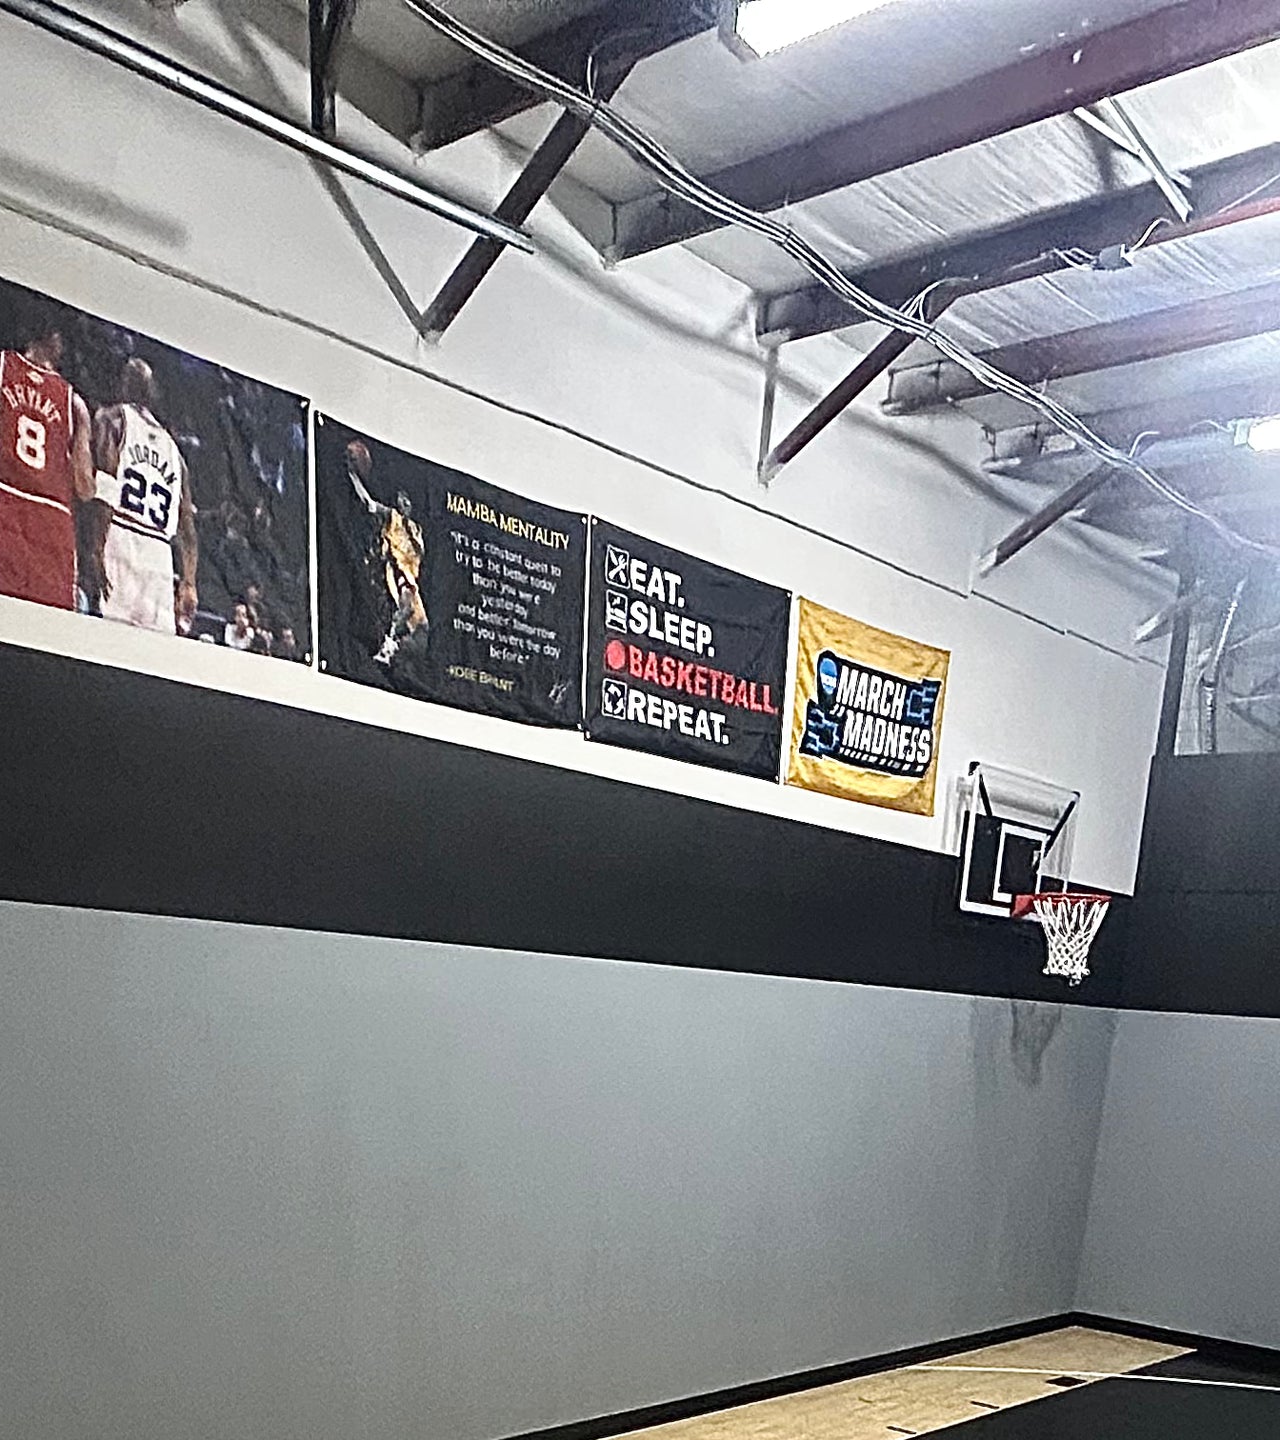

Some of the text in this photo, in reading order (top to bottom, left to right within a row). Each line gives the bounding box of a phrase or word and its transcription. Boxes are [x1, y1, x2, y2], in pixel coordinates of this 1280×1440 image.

[16, 414, 46, 470] 8
[128, 443, 177, 486] JORDAN
[121, 467, 173, 531] 23
[446, 491, 570, 551] MAMBA MENTALITY
[472, 556, 483, 569] to
[530, 575, 557, 595] today
[550, 564, 562, 578] to
[631, 558, 685, 608] EAT.
[477, 627, 495, 641] you
[543, 643, 561, 659] day
[629, 600, 715, 657] SLEEP.
[629, 645, 779, 715] BASKETBALL.
[836, 665, 907, 721] MARCH
[627, 688, 730, 745] REPEAT.
[841, 709, 931, 763] MADNESS
